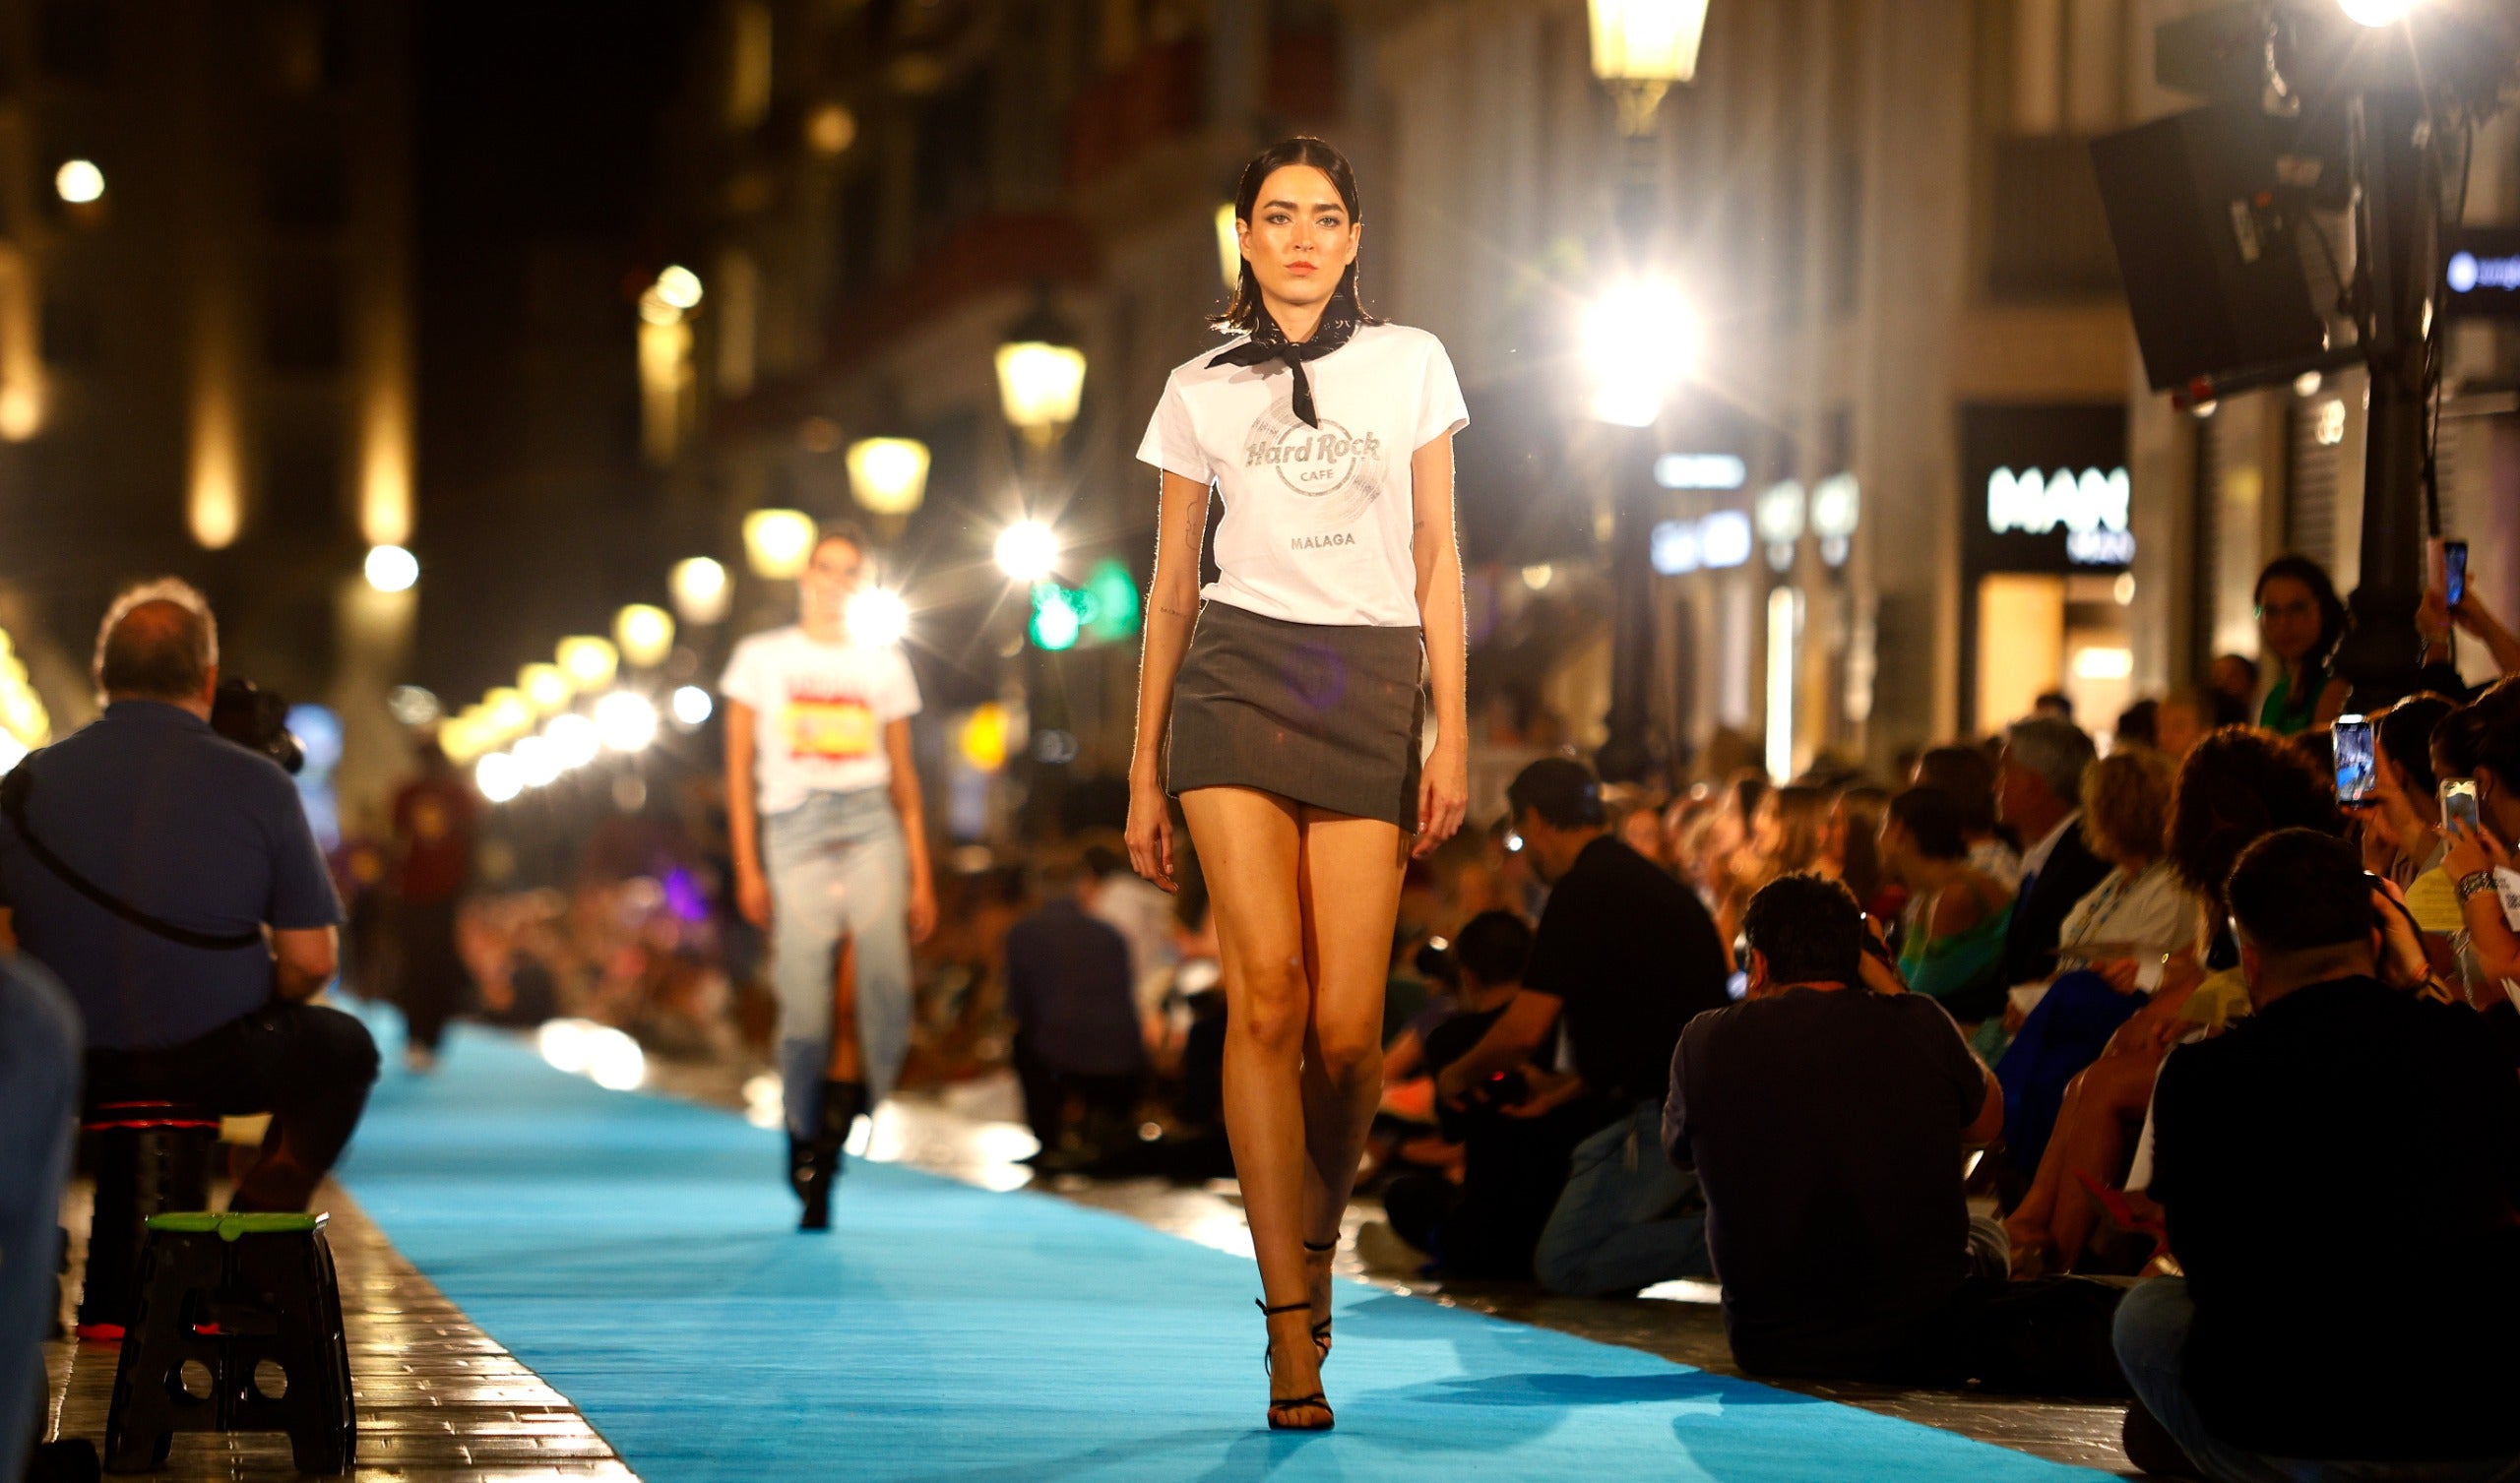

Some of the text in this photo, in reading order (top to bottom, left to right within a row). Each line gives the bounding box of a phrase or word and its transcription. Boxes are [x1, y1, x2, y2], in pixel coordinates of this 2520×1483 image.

[1245, 432, 1380, 467] Hard Rock
[1300, 469, 1334, 482] CAFE
[1291, 532, 1355, 550] MALAGA
